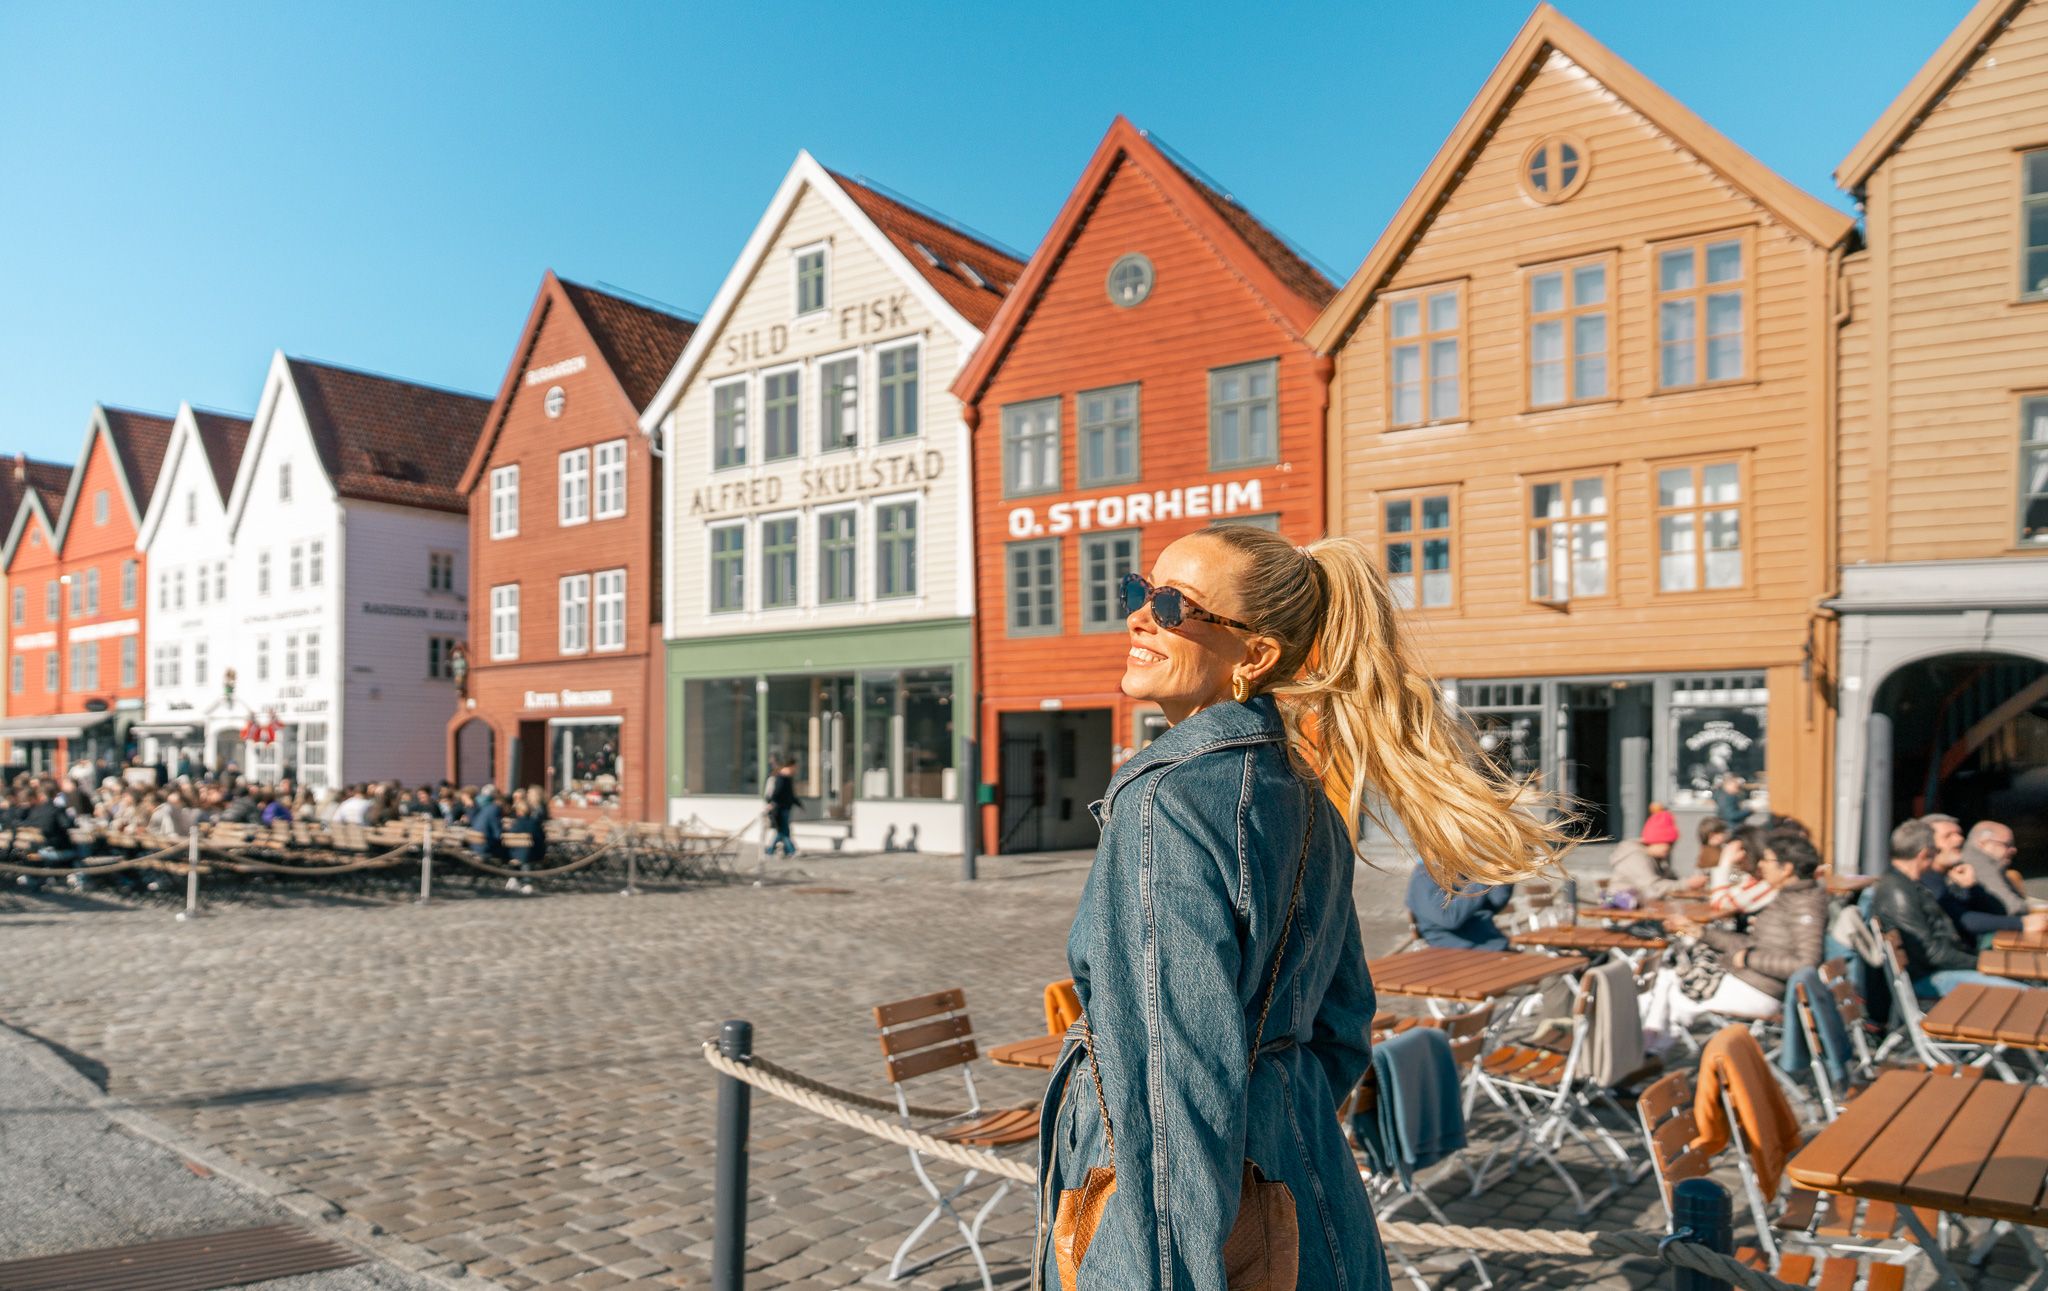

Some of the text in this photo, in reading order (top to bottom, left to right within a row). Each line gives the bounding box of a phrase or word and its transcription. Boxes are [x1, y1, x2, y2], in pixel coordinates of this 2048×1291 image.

[726, 324, 788, 366] SILD
[840, 293, 908, 340] FISK
[689, 449, 945, 516] ALFRED SKULSTAD
[1008, 479, 1263, 538] O. STORHEIM
